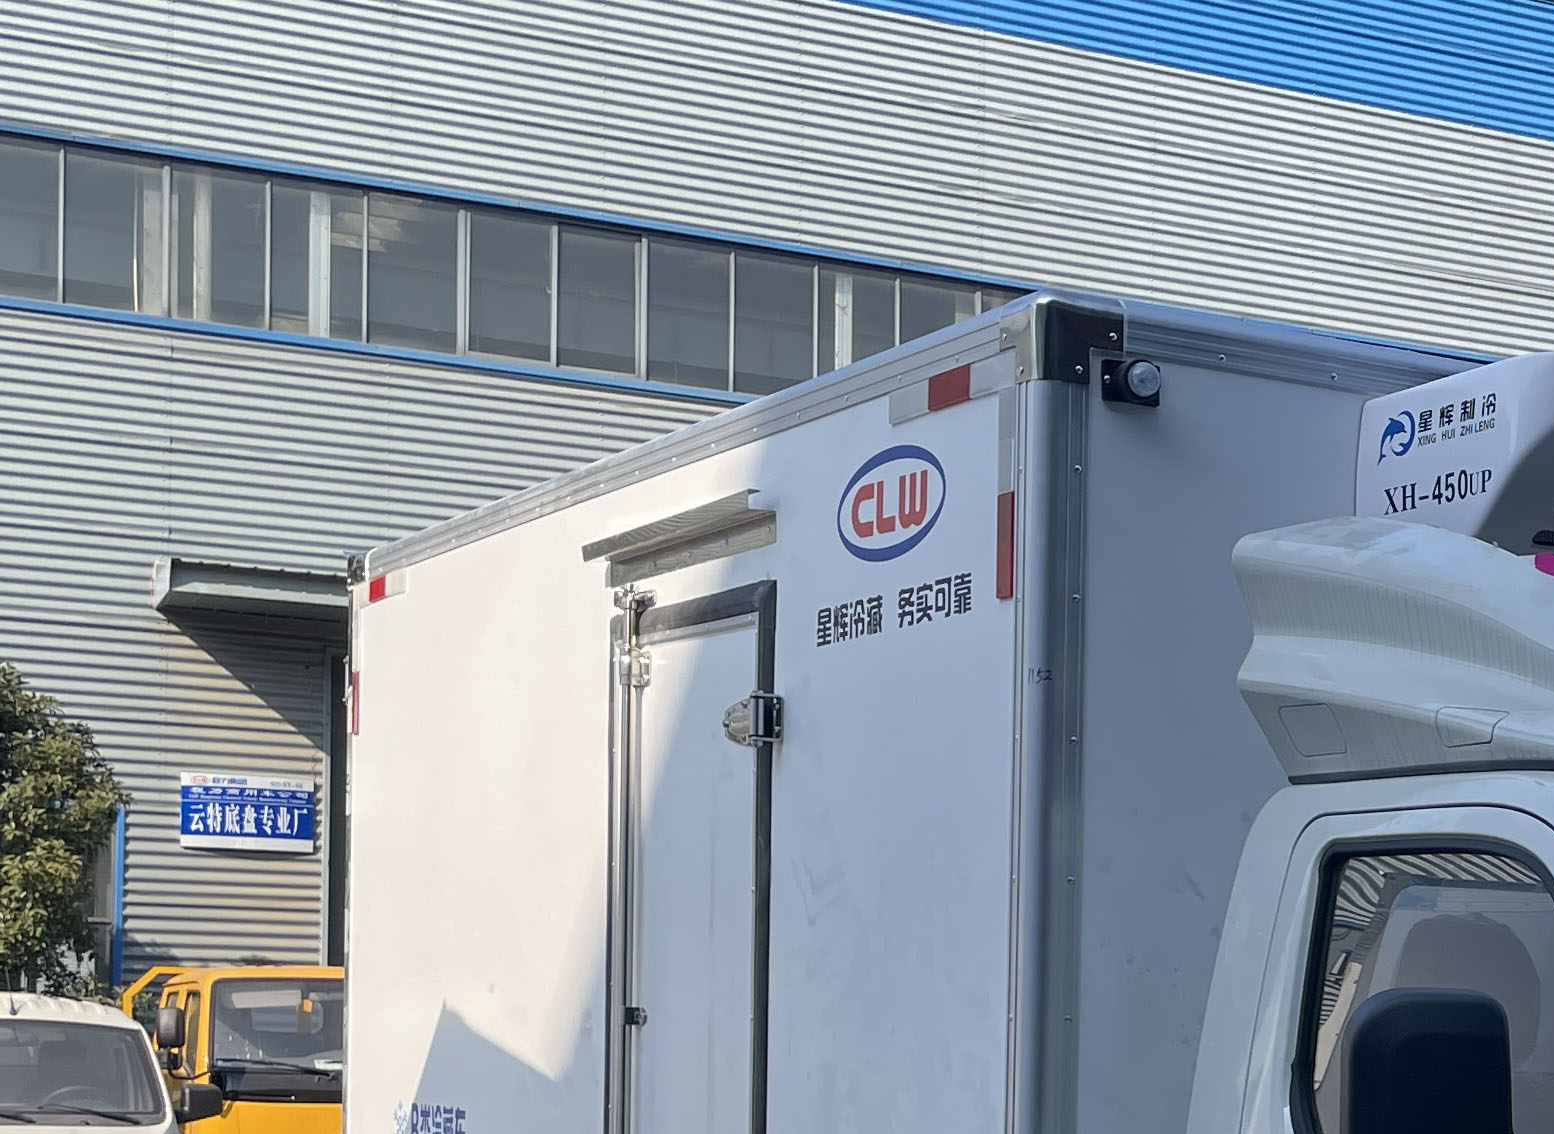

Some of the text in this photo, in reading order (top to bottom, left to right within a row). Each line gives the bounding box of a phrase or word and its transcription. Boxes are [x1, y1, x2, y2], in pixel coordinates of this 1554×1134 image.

[1417, 392, 1497, 433] 星辉制冷
[1417, 417, 1496, 448] XING HUI ZHI LENG
[851, 469, 928, 538] CLW
[1383, 468, 1493, 515] XH-450UP
[816, 572, 972, 647] 星辉冷藏 务实可靠
[188, 801, 308, 837] 云特底盘专业厂
